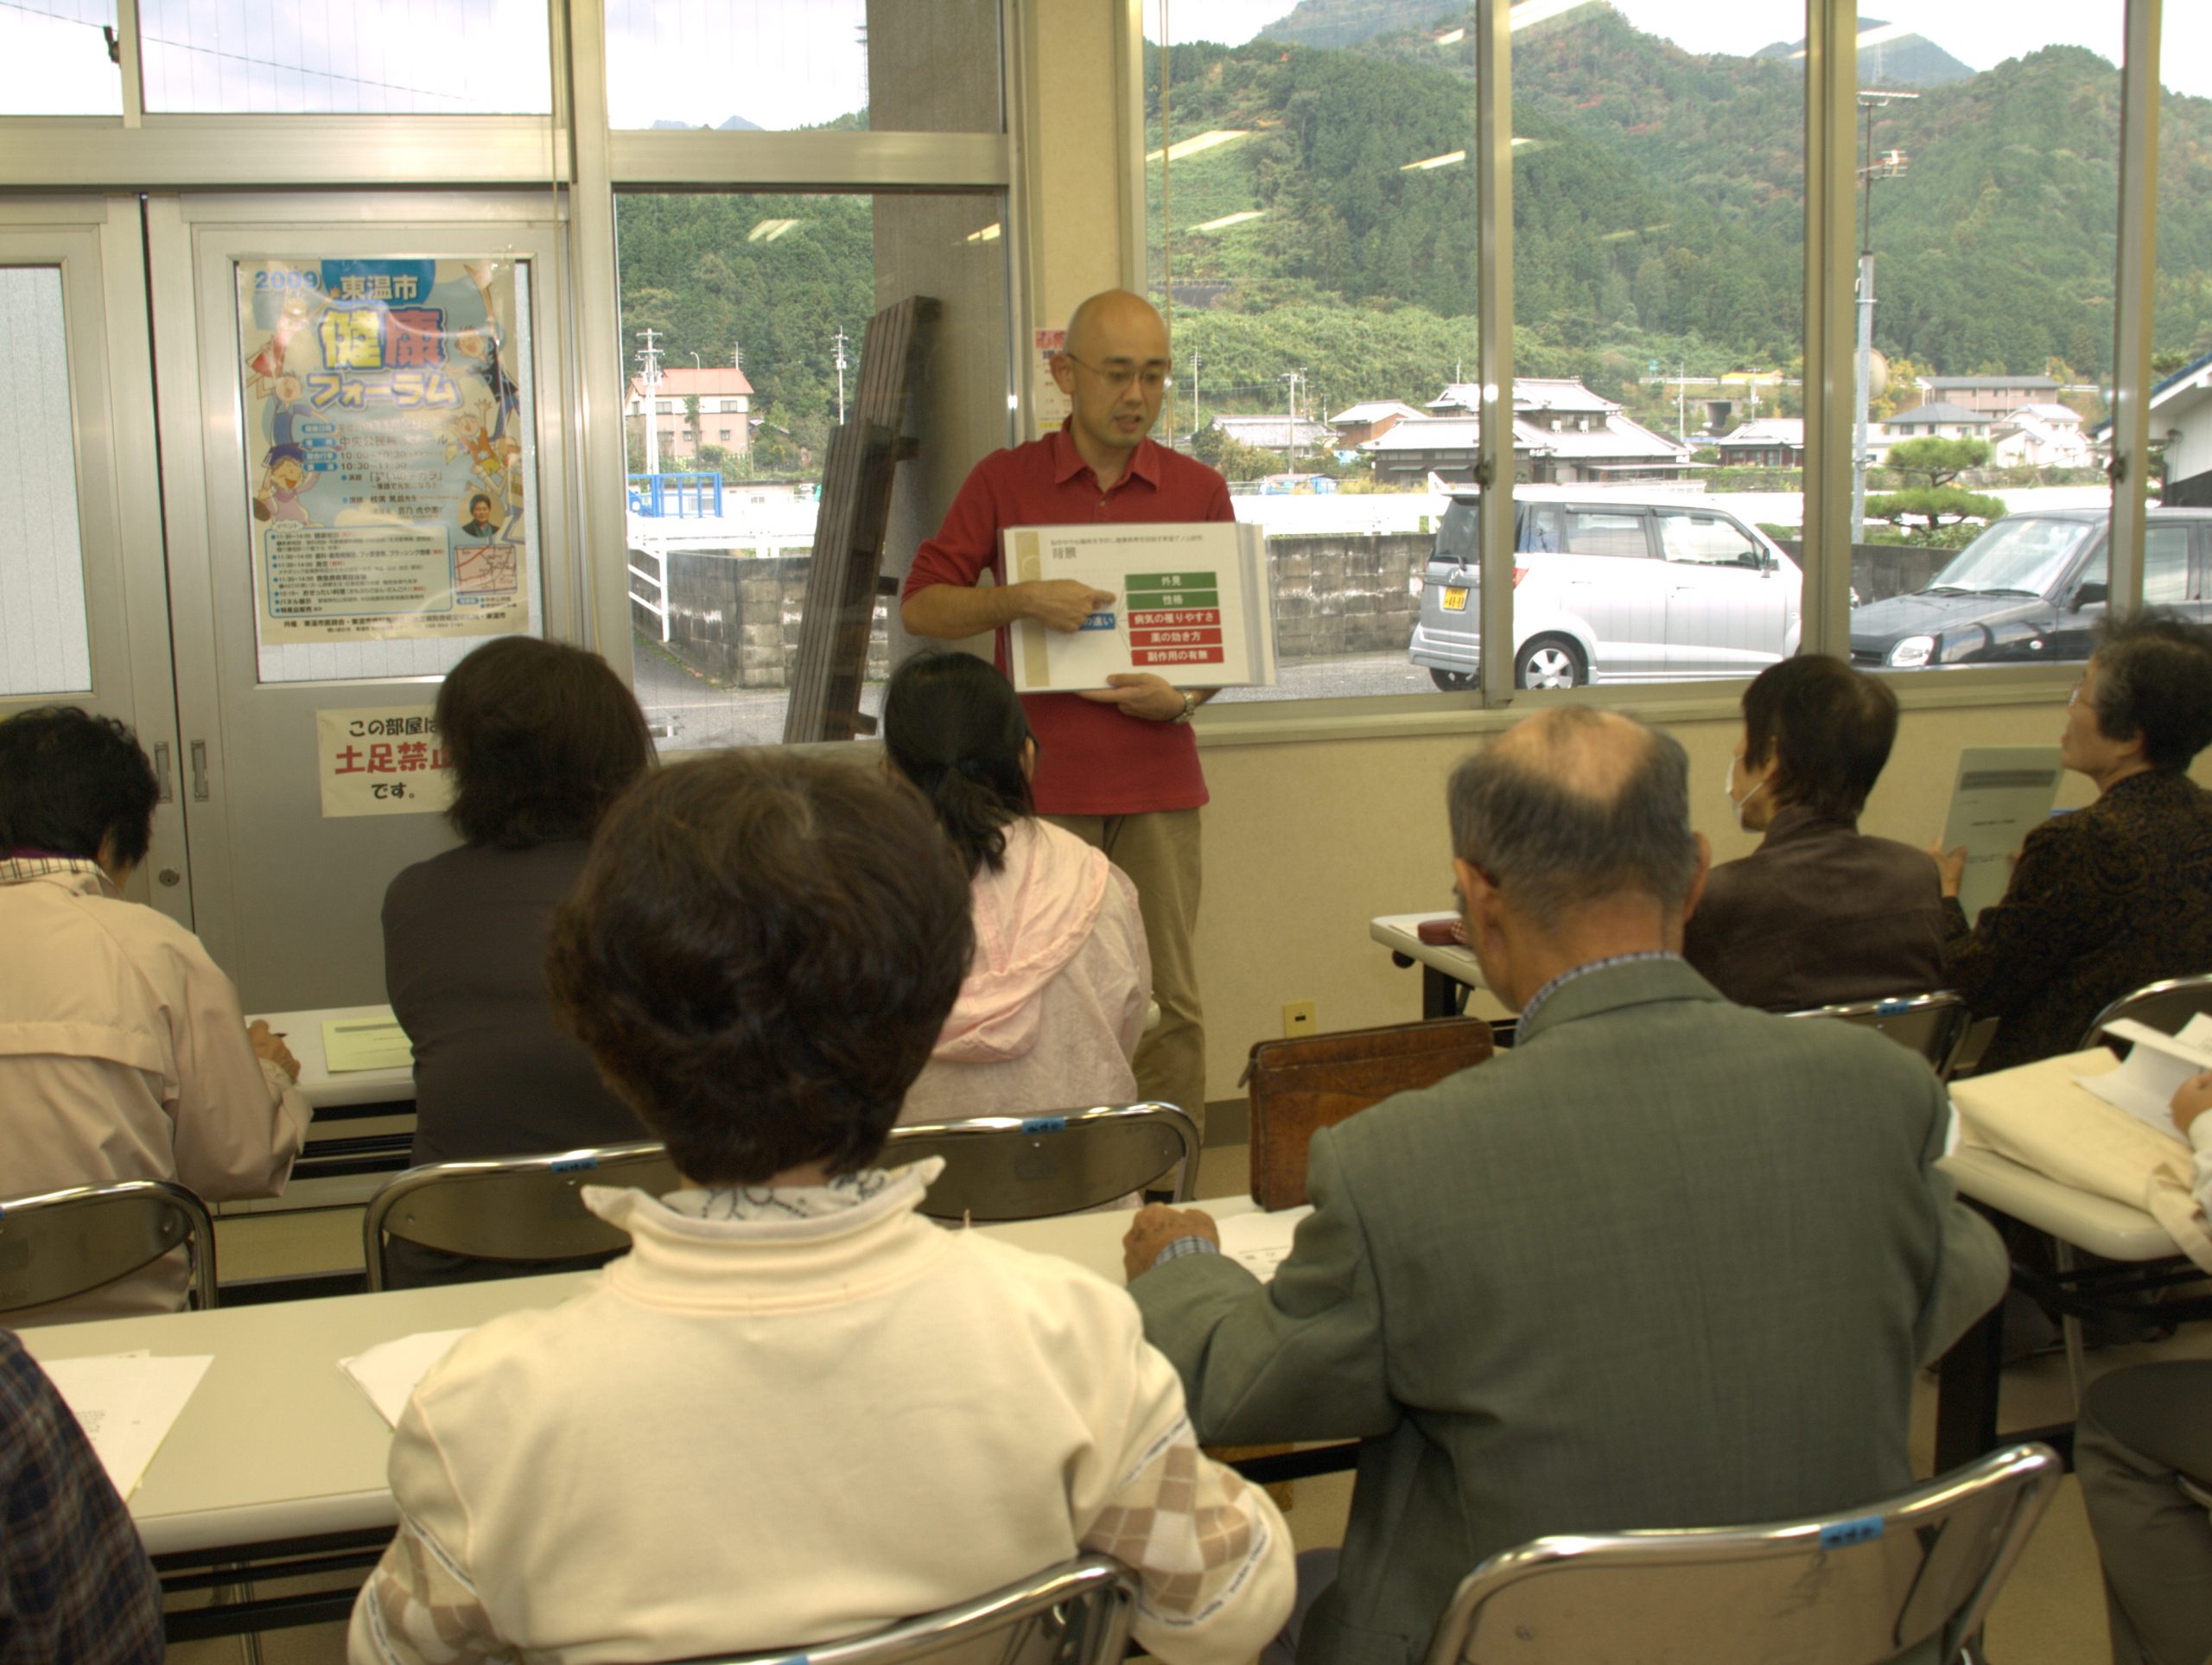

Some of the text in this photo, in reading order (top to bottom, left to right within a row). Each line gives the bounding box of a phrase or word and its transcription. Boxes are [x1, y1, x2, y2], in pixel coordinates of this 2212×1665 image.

[254, 270, 320, 290] 2009
[340, 275, 418, 301] 東温市
[318, 307, 446, 370] 健康
[307, 373, 461, 410] フォーラム
[1161, 575, 1182, 587] 外見
[1162, 594, 1184, 606] 性格
[1151, 631, 1201, 643] 薬の効き方
[1147, 650, 1209, 663] 副作用の有無
[334, 740, 456, 776] 土足禁止
[371, 782, 415, 800] です。
